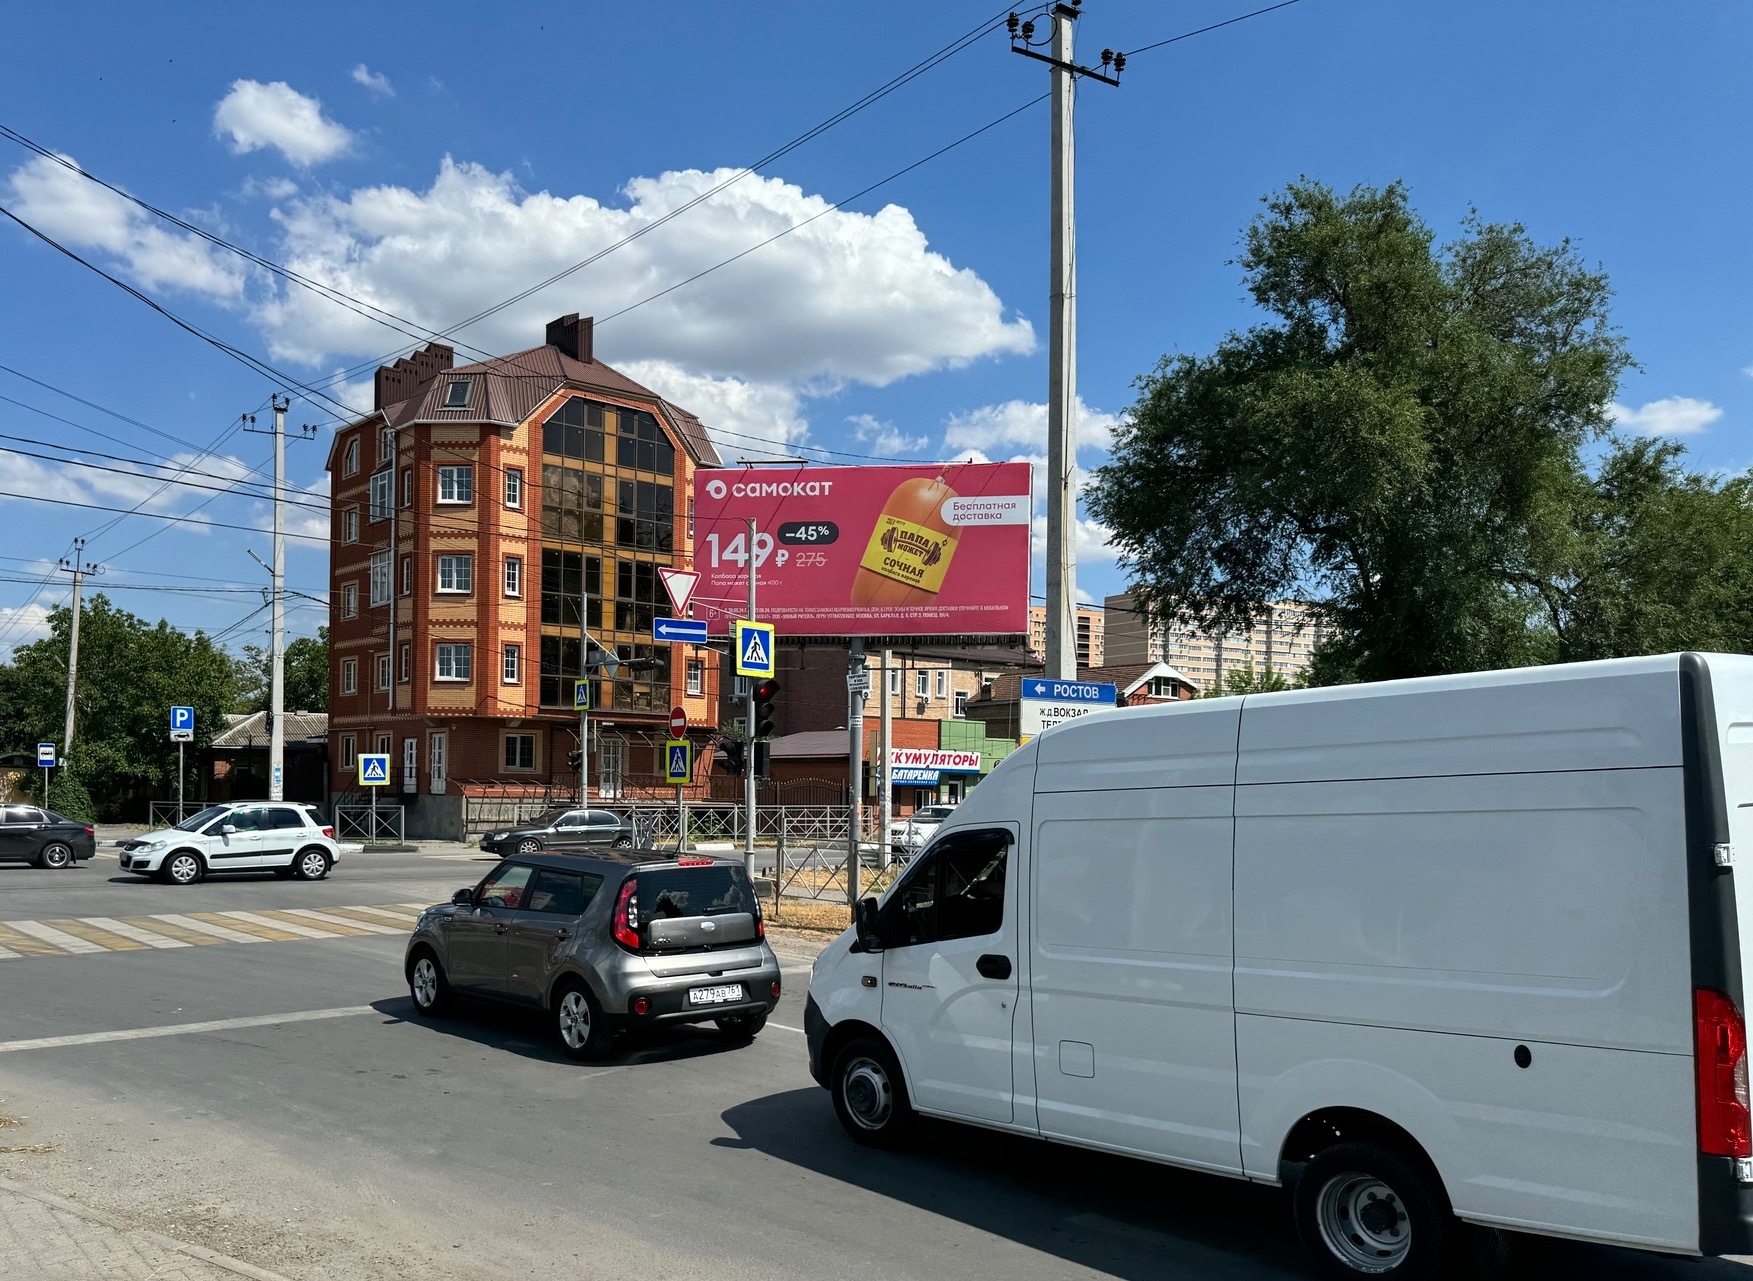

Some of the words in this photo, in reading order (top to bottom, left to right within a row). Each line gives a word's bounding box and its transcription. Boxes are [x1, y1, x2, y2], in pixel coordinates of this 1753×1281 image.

[732, 482, 832, 497] самокат
[954, 502, 1016, 510] Бесплатная
[953, 512, 1002, 521] доставка
[900, 530, 930, 548] ПАПА
[897, 543, 924, 557] МОЖЕТ
[796, 552, 827, 566] 275
[884, 557, 924, 578] СОЧНАЯ
[709, 609, 717, 618] 6+
[1054, 684, 1099, 699] РОСТОВ
[176, 709, 188, 727] P
[891, 752, 979, 766] КУМУЛЯТОРЫ
